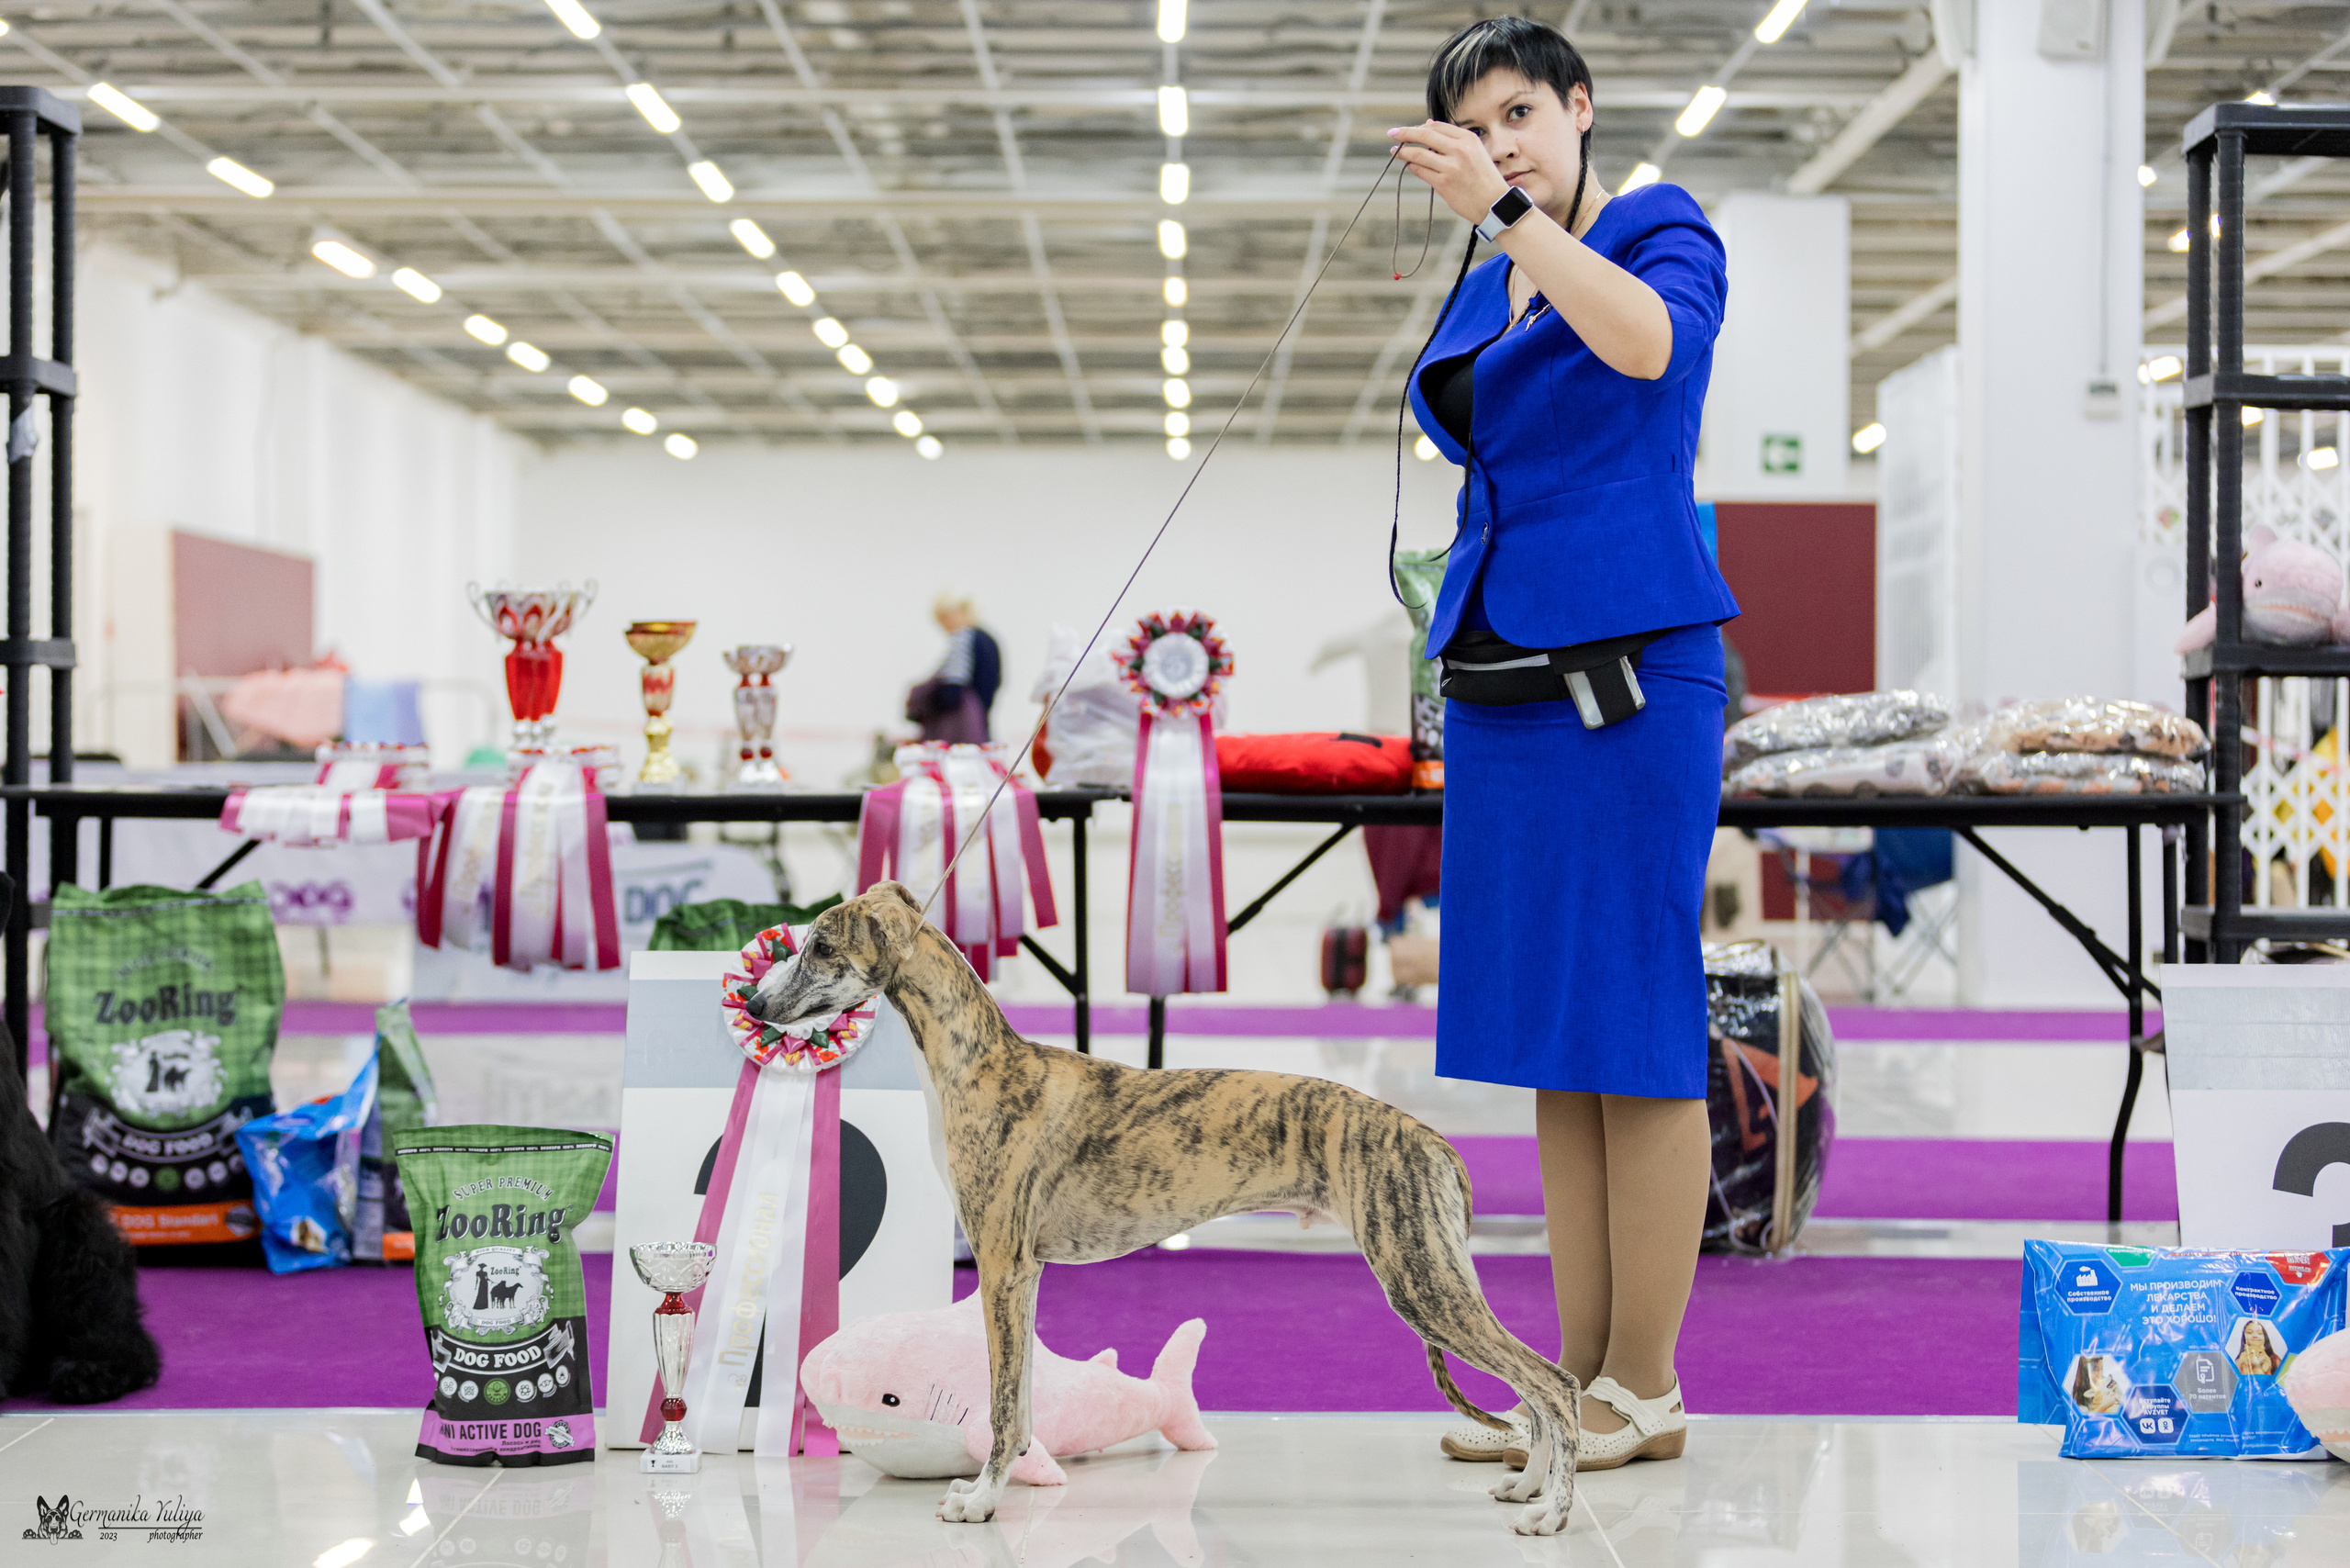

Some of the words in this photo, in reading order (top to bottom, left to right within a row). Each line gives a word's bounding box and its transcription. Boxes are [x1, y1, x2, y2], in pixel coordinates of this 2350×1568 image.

[95, 982, 236, 1026] ZooRing
[164, 1132, 214, 1156] FOOD
[453, 1178, 493, 1201] SUPER
[498, 1176, 554, 1201] PREMIUM
[436, 1204, 566, 1244] ZooRing
[490, 1266, 520, 1276] ZooRing
[718, 1193, 779, 1367] Профессионал
[2130, 1282, 2147, 1292] МЫ
[2150, 1280, 2221, 1290] ПРОИЗВОДИМ
[2234, 1292, 2277, 1301] производство
[2235, 1285, 2275, 1294] Контрактное
[2146, 1292, 2208, 1302] ЛЕКАРСТВА
[2151, 1305, 2158, 1313] И
[2161, 1303, 2206, 1314] ДЕЛАЕМ
[2142, 1316, 2164, 1325] ЭТО
[2167, 1315, 2217, 1324] ХОРОШО!
[453, 1348, 489, 1368] DOG
[493, 1345, 542, 1368] FOOD
[460, 1424, 508, 1439] ACTIVE
[514, 1422, 542, 1439] DOG
